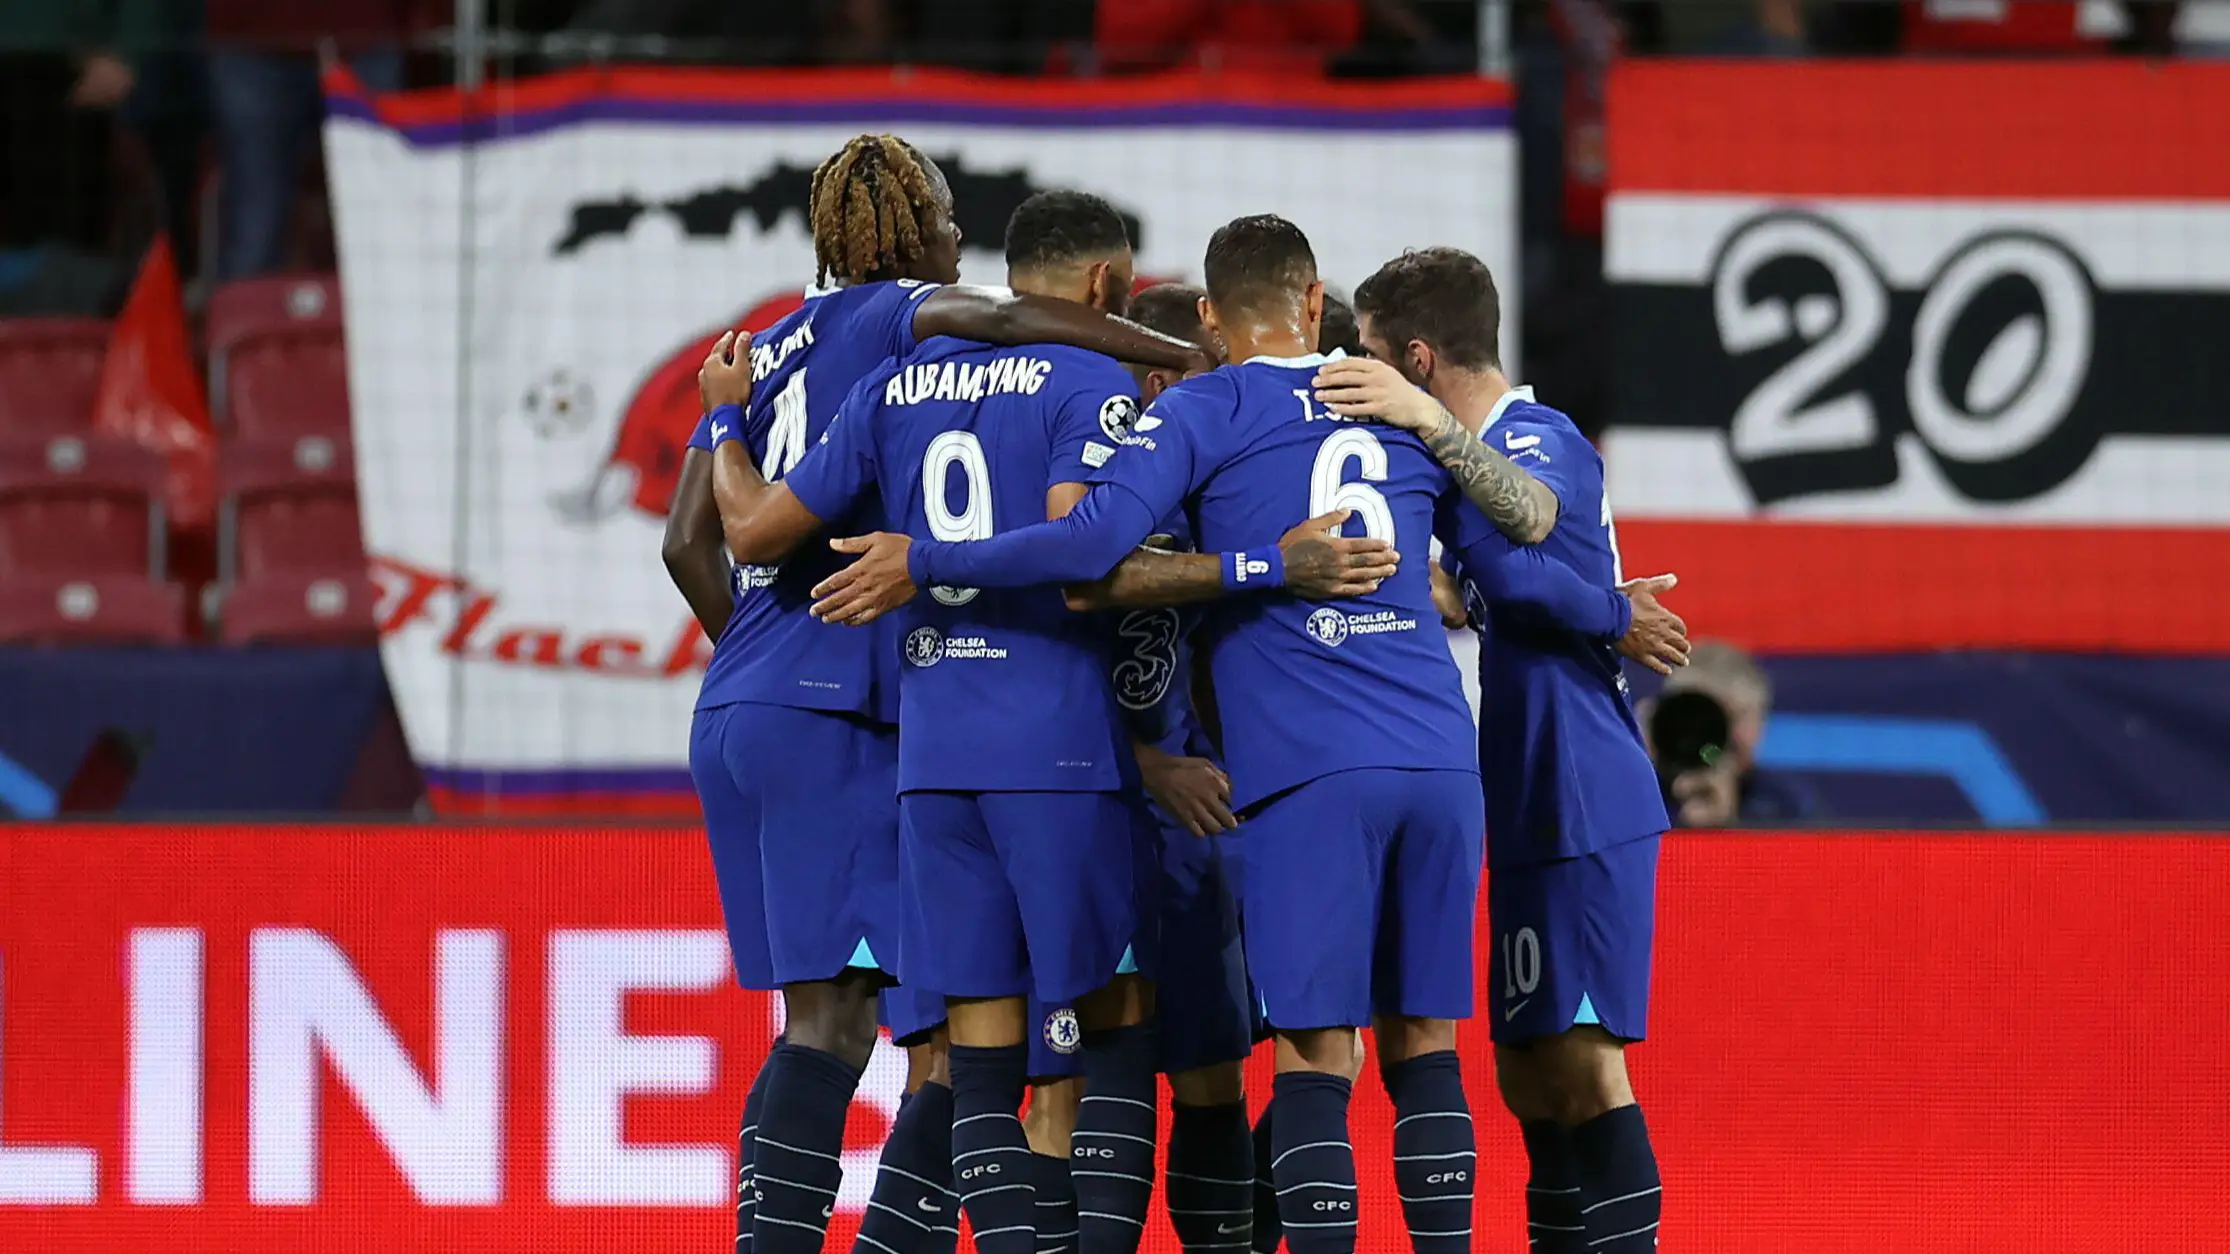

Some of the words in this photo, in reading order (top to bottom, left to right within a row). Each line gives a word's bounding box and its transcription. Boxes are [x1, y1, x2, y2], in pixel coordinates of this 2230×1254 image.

[1708, 208, 2104, 510] 20
[1309, 427, 1396, 584] 6
[922, 430, 994, 606] 9
[1348, 611, 1396, 625] CHELSEA
[1350, 620, 1416, 635] FOUNDATION
[945, 637, 986, 648] CHELSEA
[945, 648, 1007, 659] FOUNDATION
[1502, 926, 1541, 998] 10
[1074, 1147, 1115, 1159] CFC
[961, 1163, 1001, 1180] CFC
[1426, 1171, 1467, 1184] CFC
[1313, 1201, 1351, 1211] CFC
